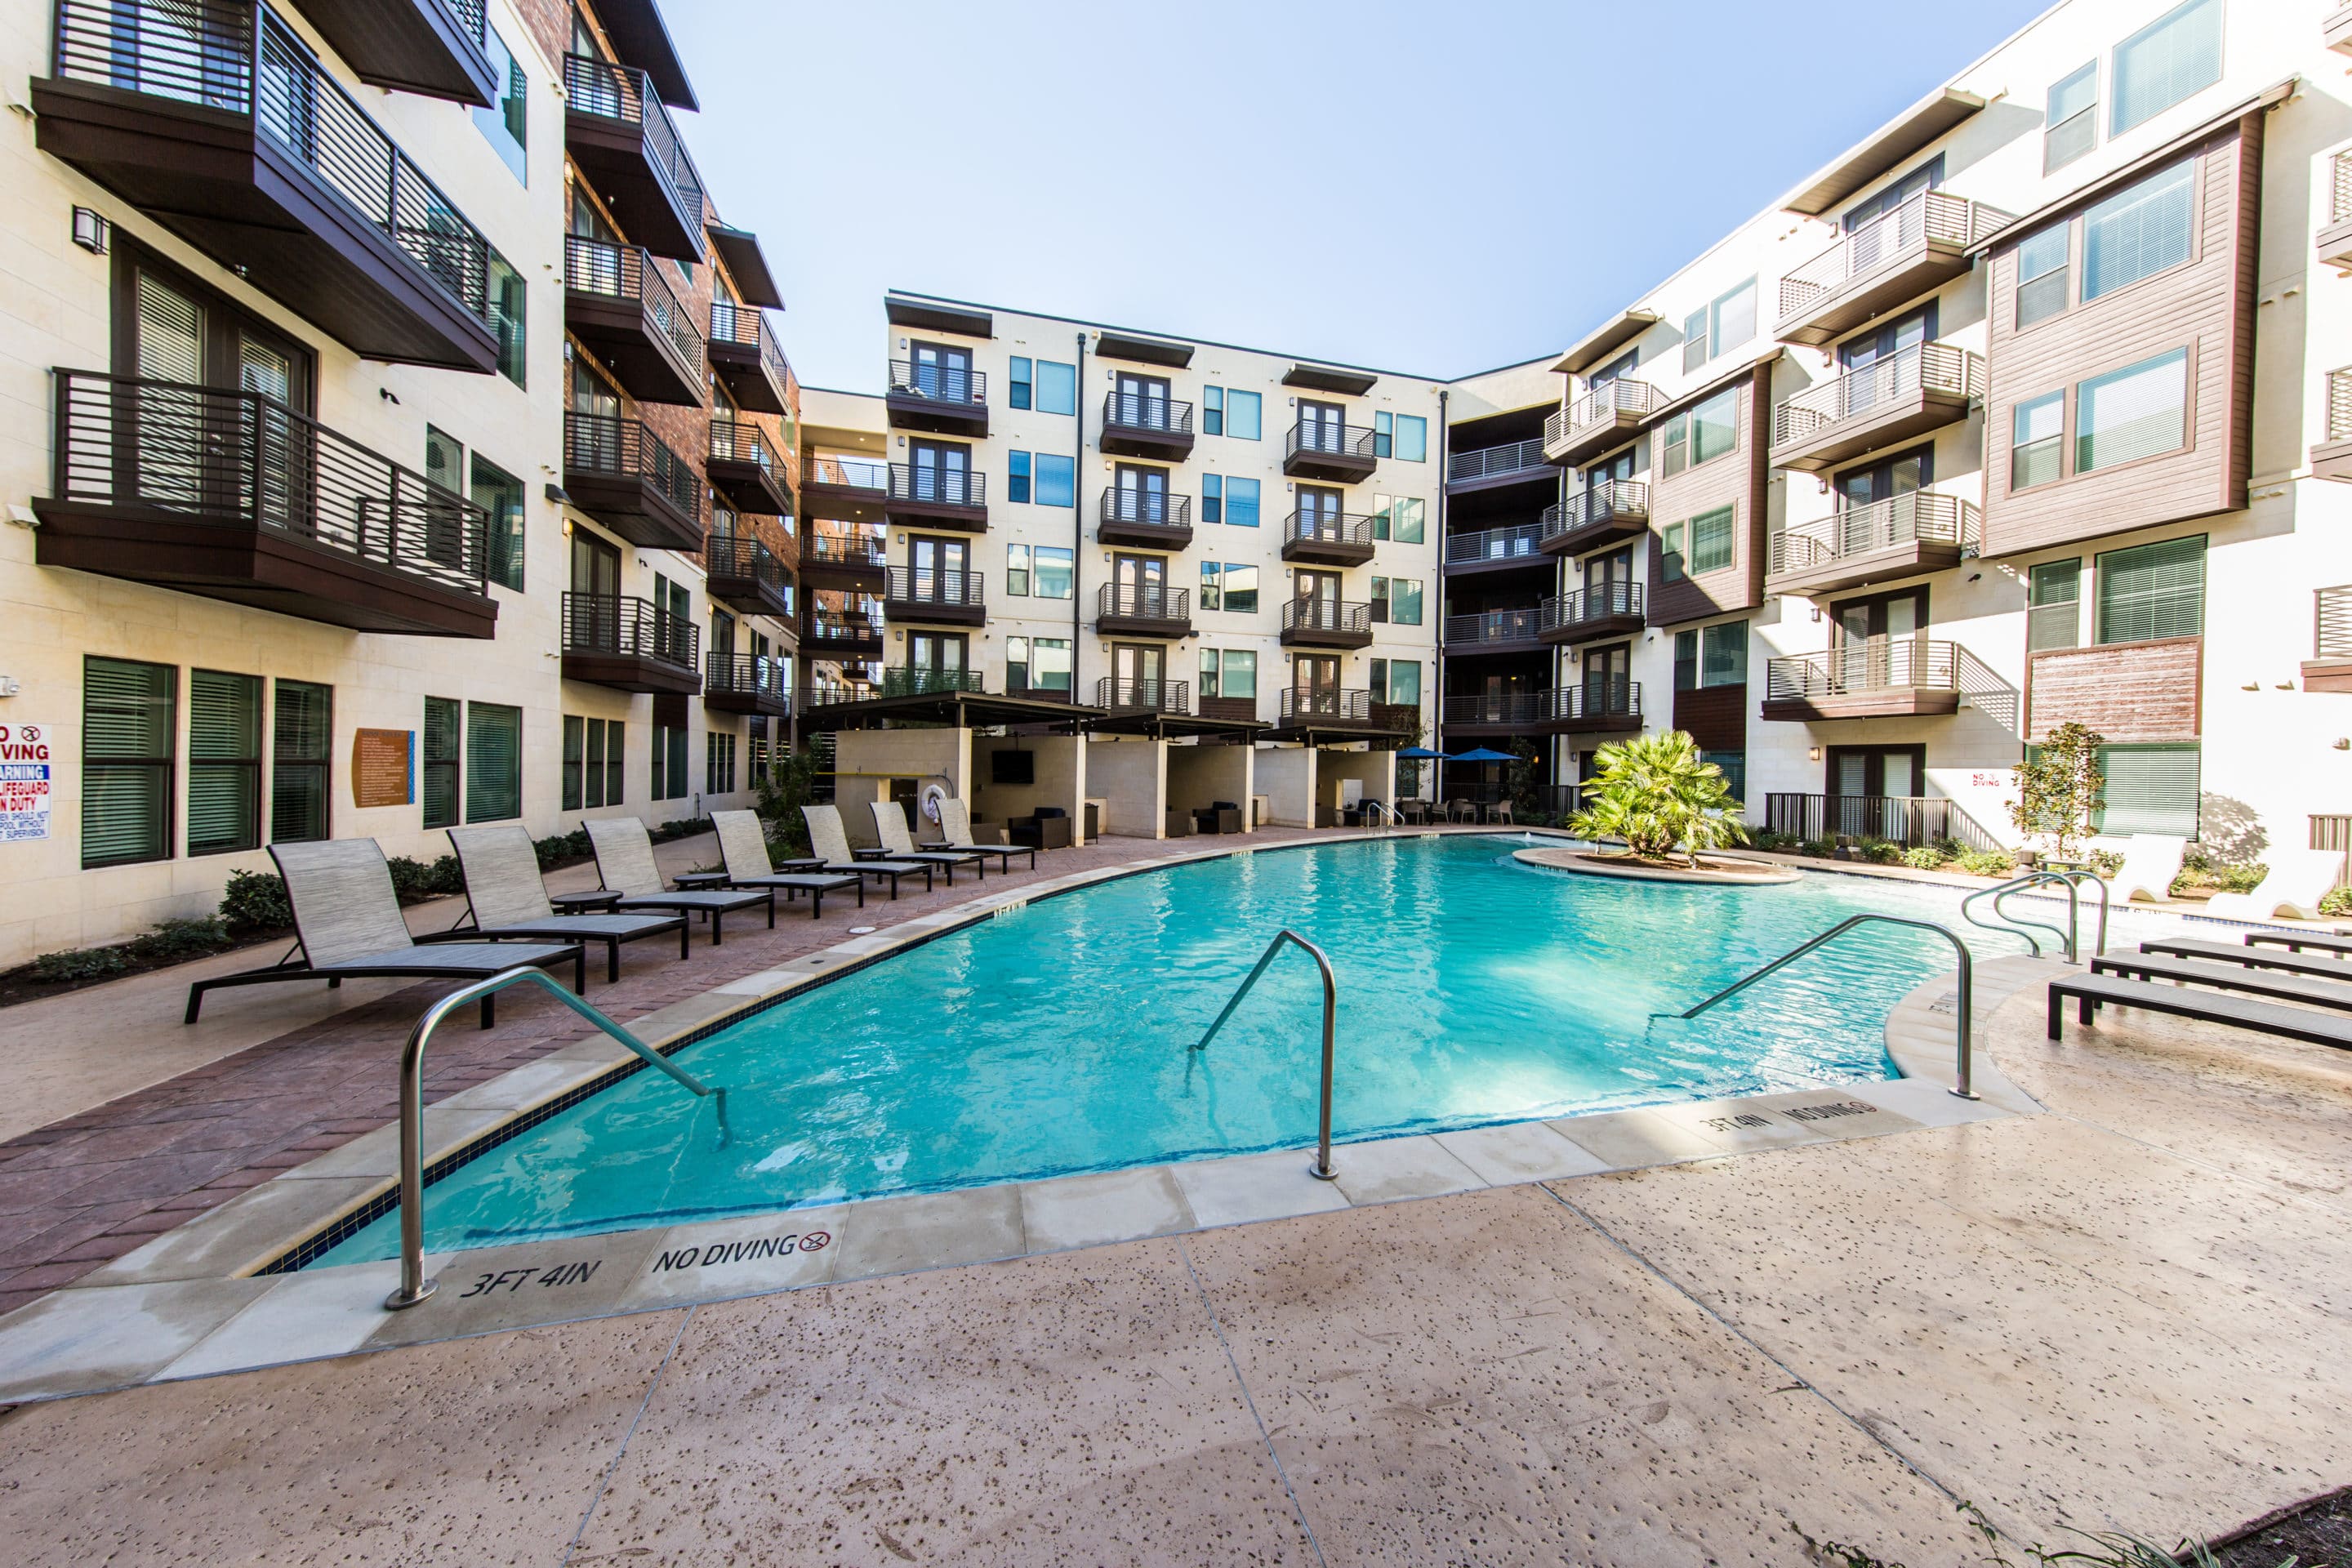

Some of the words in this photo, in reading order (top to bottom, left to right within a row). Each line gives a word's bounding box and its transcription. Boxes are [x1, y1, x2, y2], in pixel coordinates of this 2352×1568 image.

[2, 744, 49, 760] VING
[11, 797, 37, 811] DUTY
[11, 812, 34, 821] SHOULD
[37, 811, 49, 819] NOT
[19, 820, 45, 829] WITHOUT
[7, 828, 46, 839] SUPERVISION
[1781, 1108, 1819, 1121] NO
[1803, 1102, 1864, 1119] DIVING
[1699, 1118, 1742, 1131] 3FT
[1735, 1114, 1773, 1127] 4IN
[653, 1247, 700, 1273] NO
[701, 1234, 798, 1267] DIVING
[460, 1267, 540, 1298] 3FT
[537, 1259, 603, 1289] 4IN
